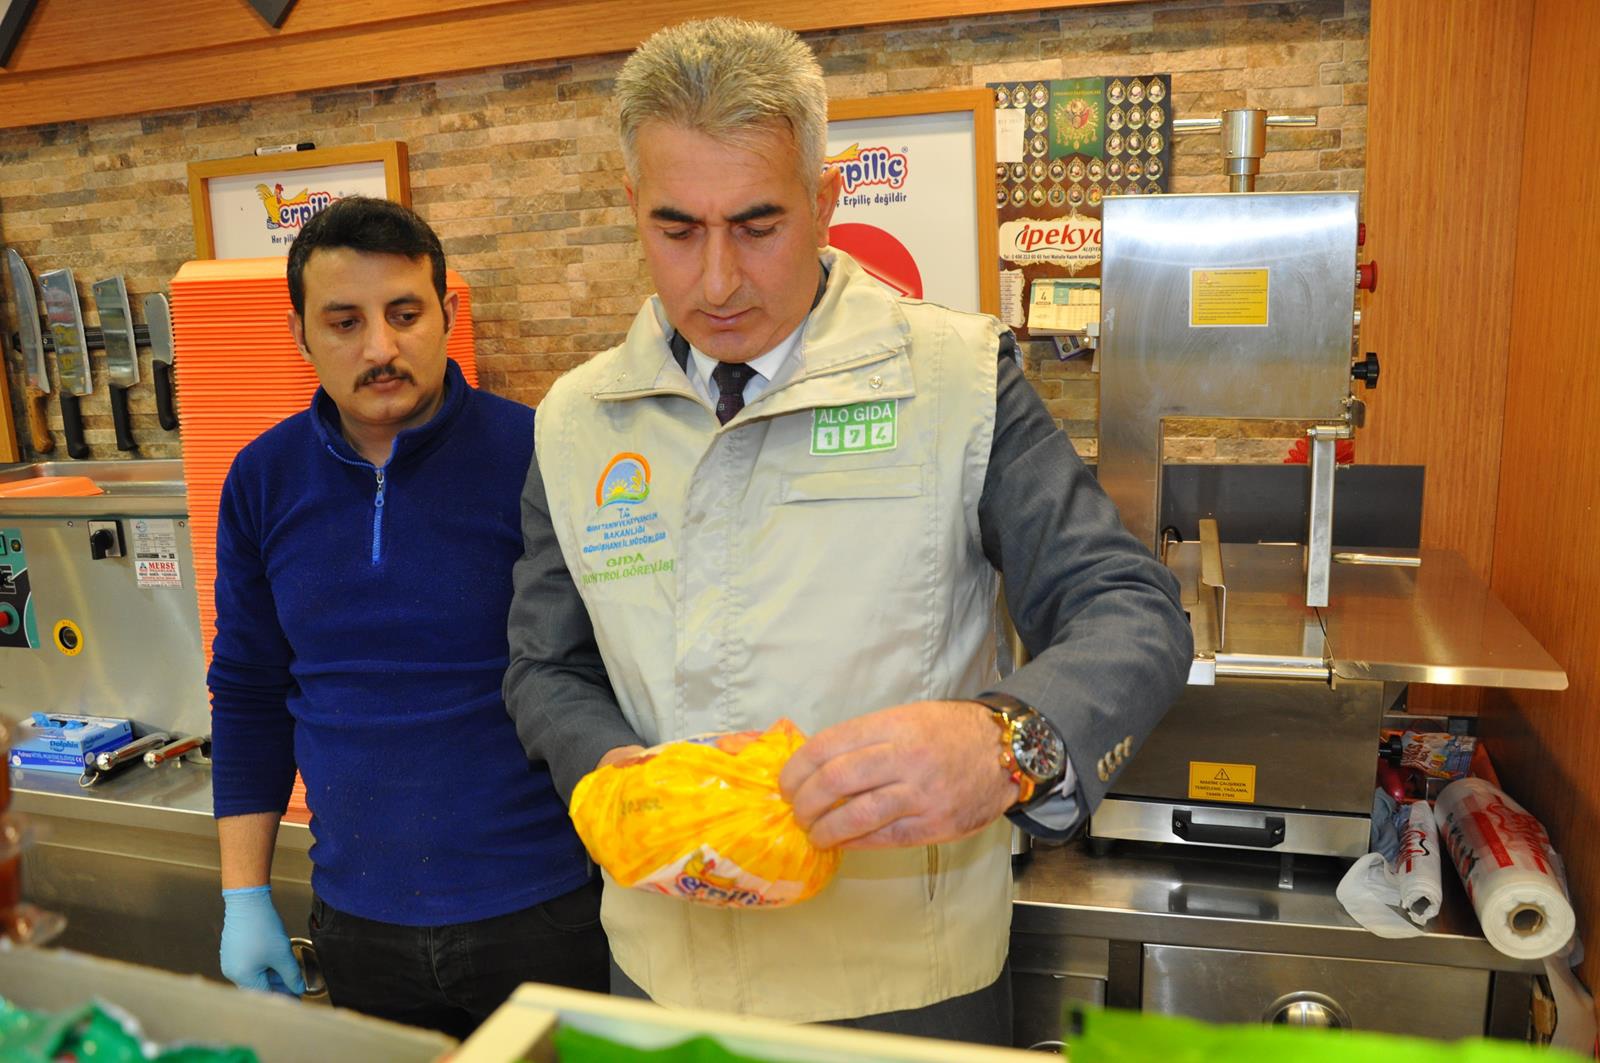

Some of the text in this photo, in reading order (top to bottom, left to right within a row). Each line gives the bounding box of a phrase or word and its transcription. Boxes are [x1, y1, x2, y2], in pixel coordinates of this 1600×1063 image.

[843, 195, 871, 208] Erpiliç
[874, 192, 907, 206] değildir
[818, 402, 893, 425] ALO GIDA
[824, 426, 887, 447] 1 7 4
[606, 553, 645, 567] GIDA
